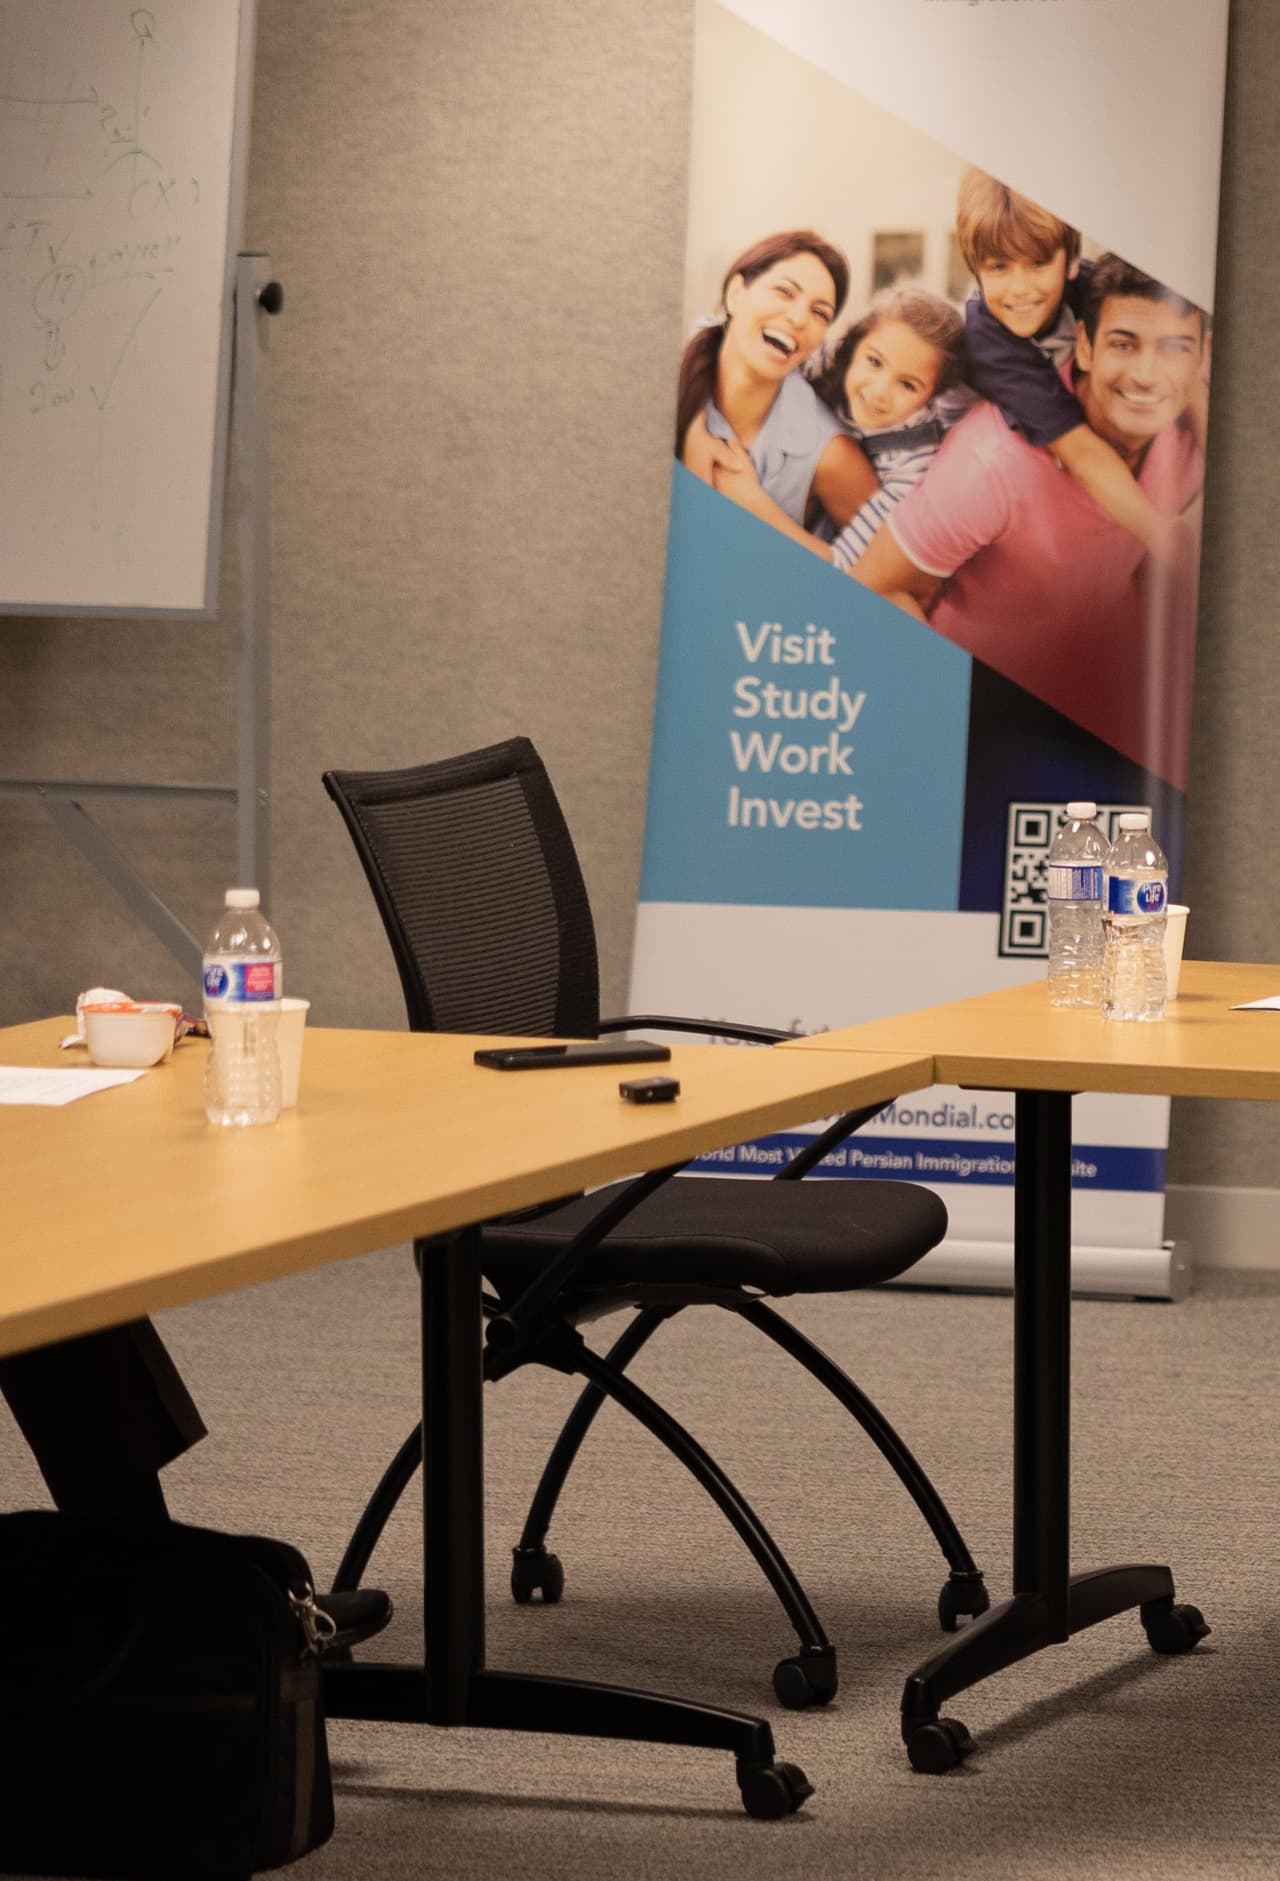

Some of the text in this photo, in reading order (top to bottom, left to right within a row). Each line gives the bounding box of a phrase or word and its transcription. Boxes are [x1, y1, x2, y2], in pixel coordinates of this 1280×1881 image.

[735, 621, 837, 665] Visit
[732, 675, 868, 733] Study
[729, 731, 856, 775] Work
[727, 785, 864, 831] Invest
[694, 1147, 736, 1161] orld
[739, 1145, 784, 1165] Most
[851, 1148, 913, 1170] Persian
